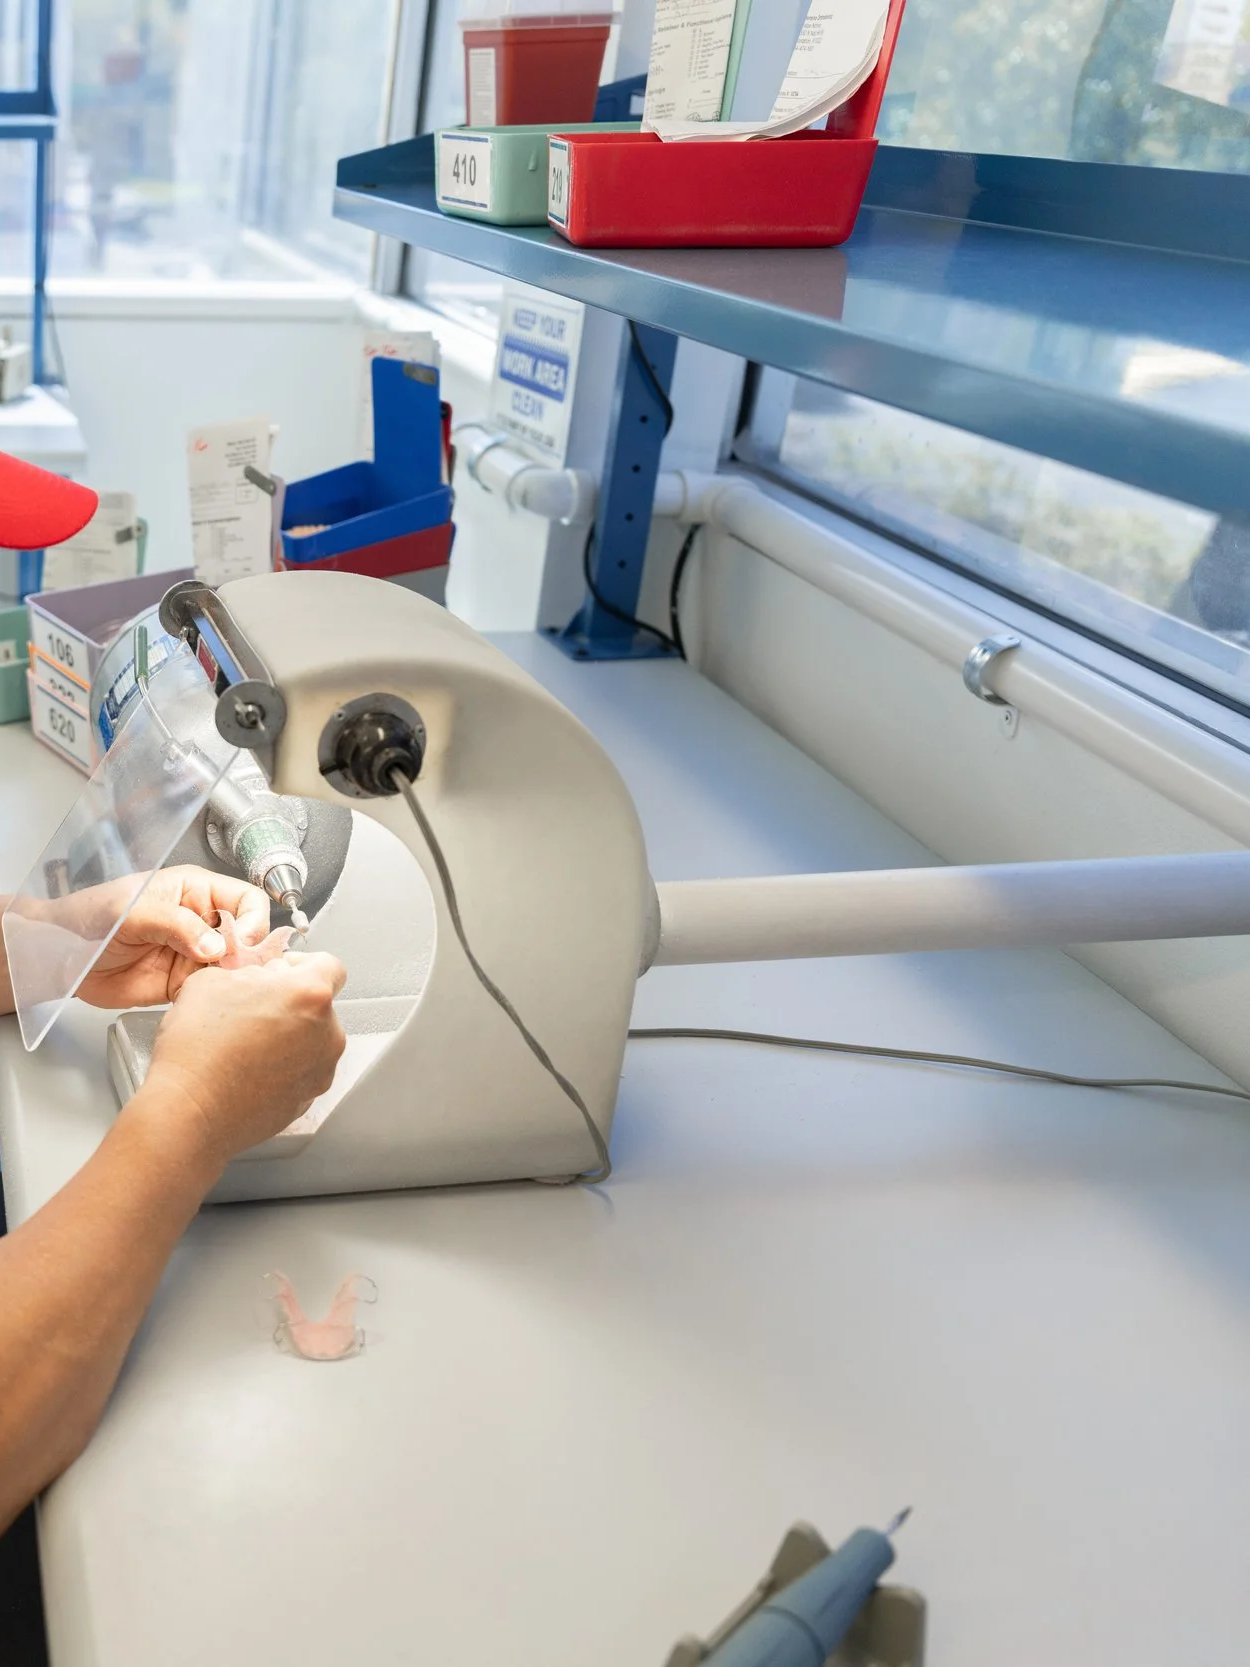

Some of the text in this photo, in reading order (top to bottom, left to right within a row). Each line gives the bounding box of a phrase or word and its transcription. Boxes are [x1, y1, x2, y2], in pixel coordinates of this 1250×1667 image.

[452, 153, 477, 186] 410
[552, 167, 563, 204] 219
[541, 316, 565, 341] YOUR
[504, 350, 564, 390] WORK AREA
[47, 633, 75, 668] 106
[49, 708, 76, 744] 620
